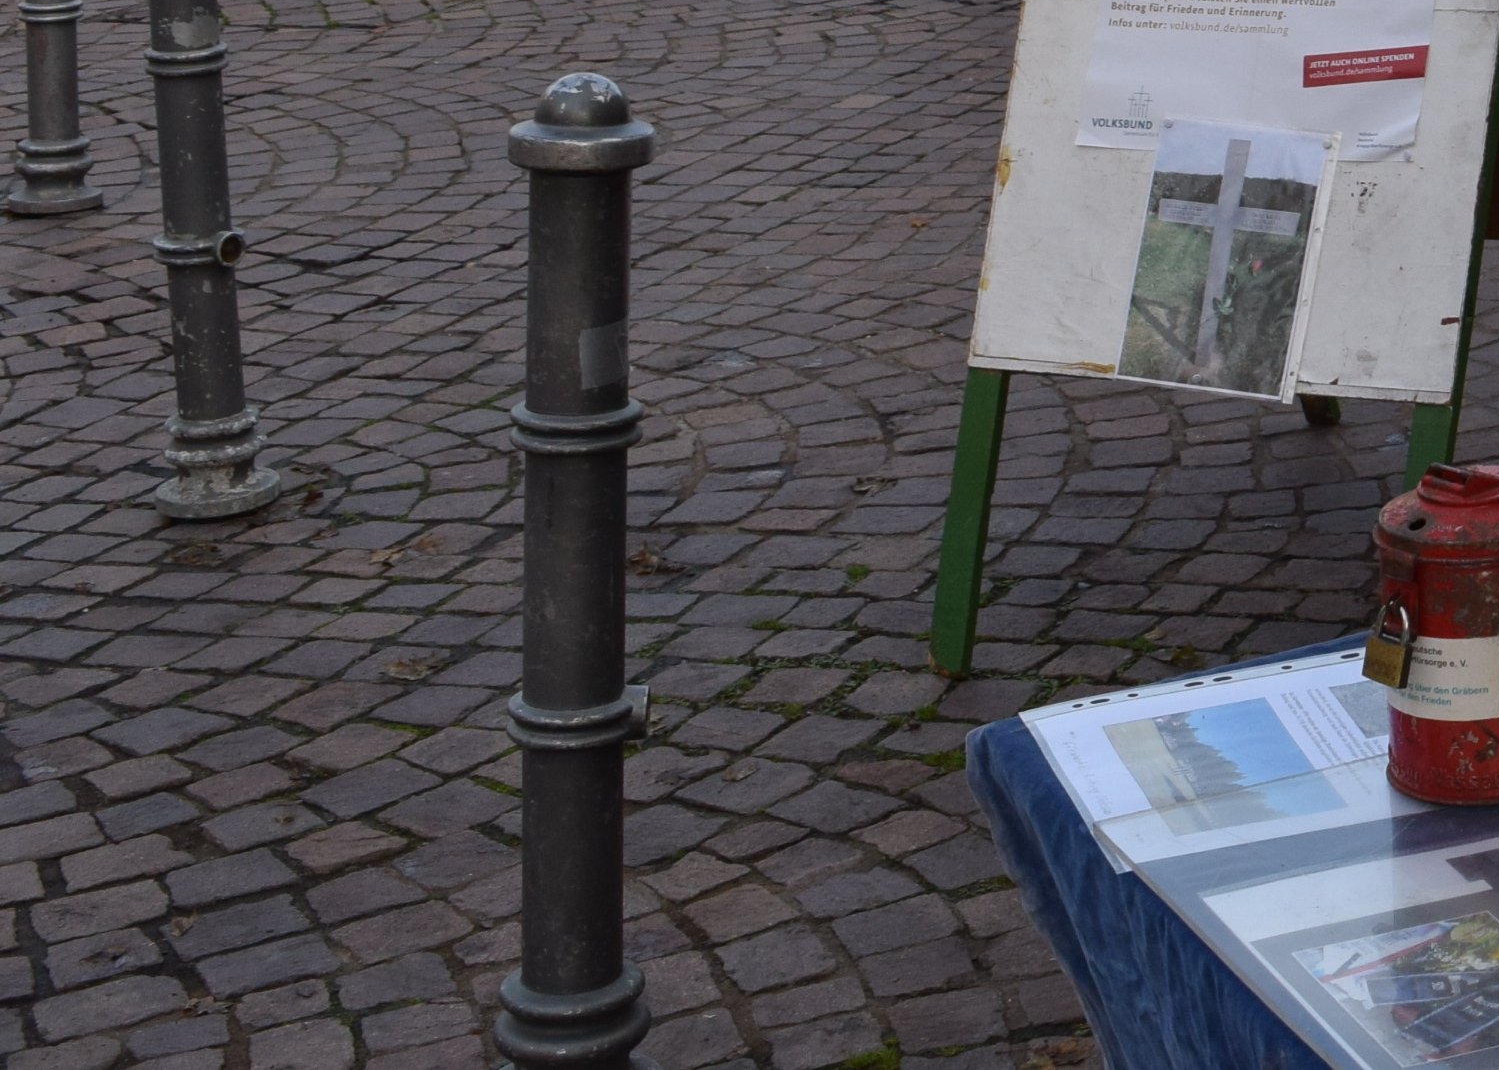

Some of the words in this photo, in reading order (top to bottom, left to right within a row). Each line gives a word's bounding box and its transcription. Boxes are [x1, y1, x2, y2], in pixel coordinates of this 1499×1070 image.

[1110, 1, 1148, 15] Beitrag
[1148, 2, 1165, 12] für
[1166, 3, 1205, 15] Frieden
[1206, 6, 1227, 16] und
[1228, 6, 1288, 20] Erinnerung.
[1107, 17, 1133, 28] Infos
[1135, 18, 1168, 29] unter:
[1169, 20, 1290, 38] volksbund.de/sammlung
[1309, 59, 1330, 69] JETZT
[1330, 57, 1351, 67] AUCH
[1351, 54, 1380, 65] ONLINE
[1380, 52, 1415, 63] SPENDEN
[1091, 117, 1154, 130] VOLKSBUND
[1459, 659, 1469, 668] V.
[1433, 685, 1450, 695] den
[1451, 686, 1489, 695] Gräbern
[1421, 694, 1452, 706] Frieden
